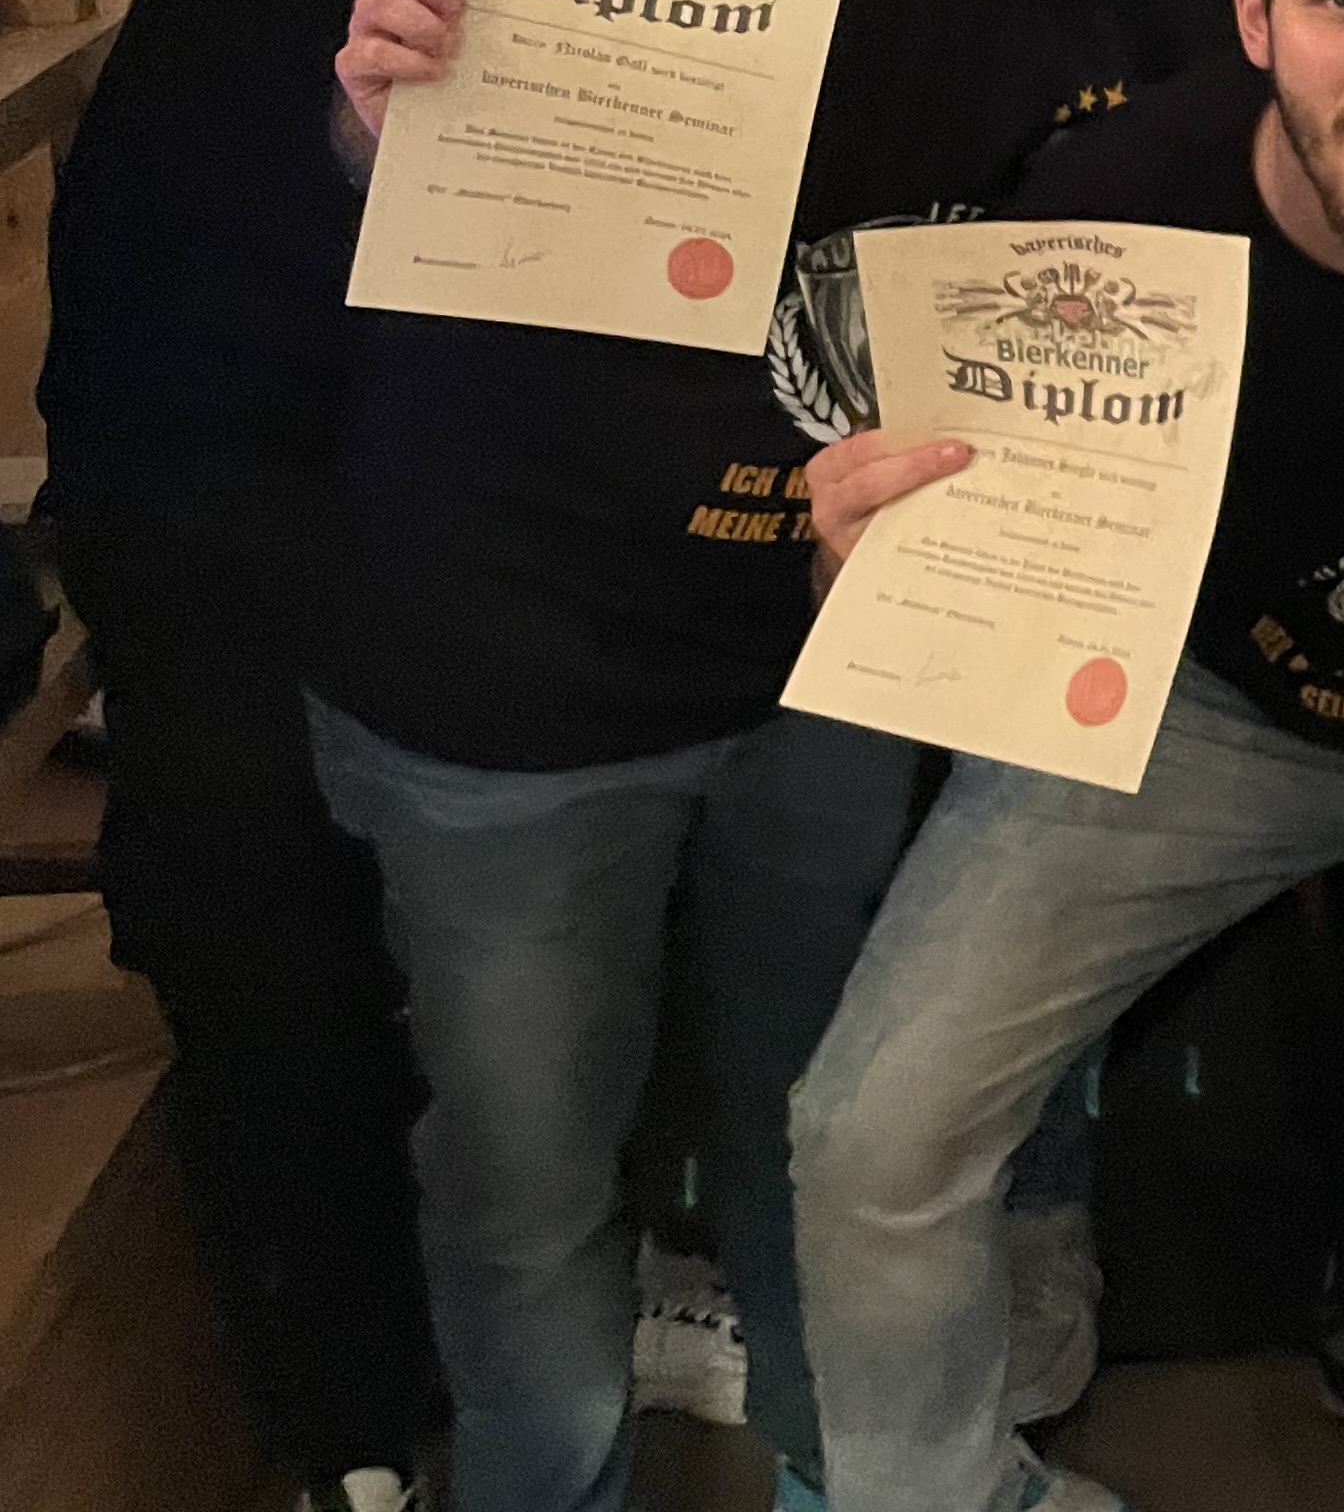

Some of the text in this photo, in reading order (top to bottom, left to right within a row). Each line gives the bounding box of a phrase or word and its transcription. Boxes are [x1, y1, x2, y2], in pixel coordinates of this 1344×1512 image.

[1009, 234, 1129, 259] bayerisches
[996, 338, 1152, 380] Bierkenner
[942, 344, 1187, 427] Diplom
[720, 462, 780, 498] ICH
[686, 504, 786, 543] MEINE
